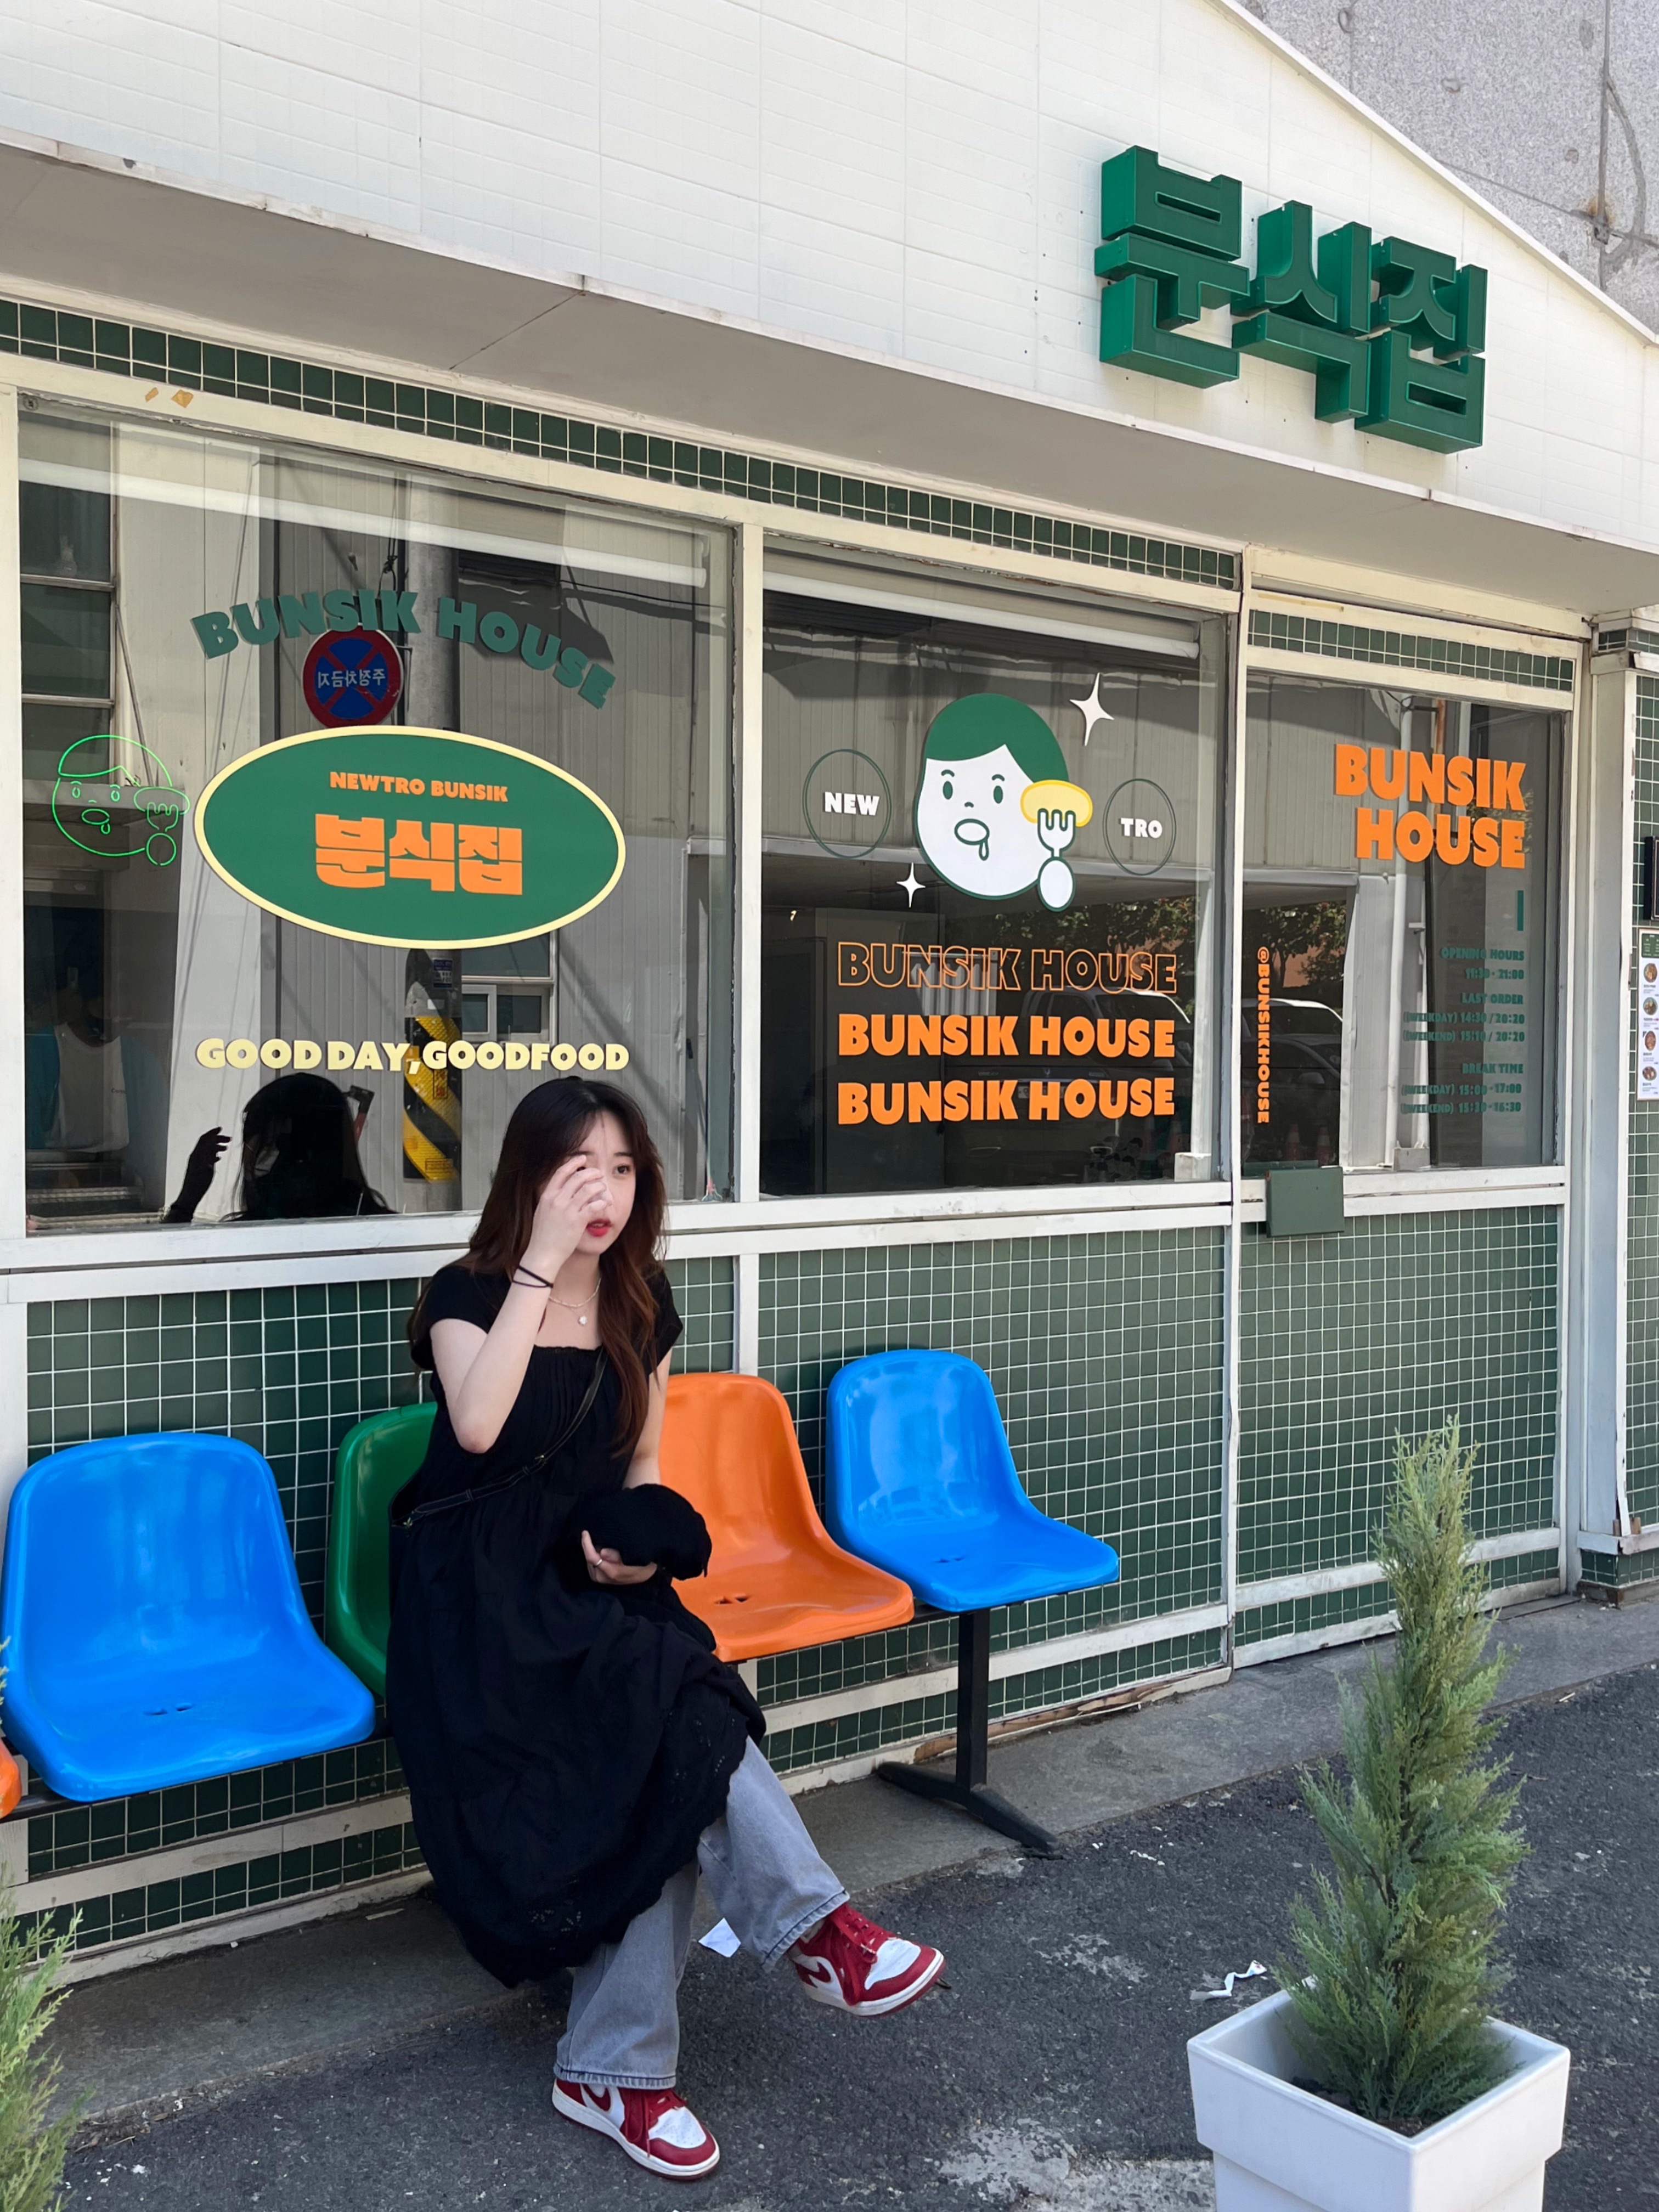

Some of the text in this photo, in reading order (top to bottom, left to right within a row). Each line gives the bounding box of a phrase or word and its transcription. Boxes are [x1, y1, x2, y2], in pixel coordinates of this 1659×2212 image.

[1095, 145, 1487, 454] 분식집
[191, 589, 616, 709] BUNSIK HOUSE
[330, 772, 508, 803] NEWTRO BUNSIK
[1335, 744, 1526, 811] BUNSIK
[825, 792, 879, 816] NEW
[1120, 817, 1163, 838] TRO
[1356, 807, 1526, 869] HOUSE
[315, 814, 523, 895] 분식집
[838, 942, 1176, 994] BUNSIK HOUSE
[1441, 947, 1524, 961] OPENING HOURS
[1465, 968, 1489, 979] 11:30
[1498, 969, 1524, 979] 21:00
[1462, 992, 1523, 1005] LAST ORDER
[838, 1013, 1175, 1058] BUNSIK HOUSE
[1257, 946, 1270, 1124] @BUNSIKHOUSE
[1496, 1031, 1525, 1042] 20:20
[198, 1039, 321, 1069] GOOD
[1463, 1063, 1523, 1074] BREAK TIME
[838, 1078, 1175, 1125] BUNSIK HOUSE
[1459, 1085, 1487, 1095] 15:00
[1494, 1083, 1522, 1093] 17:00
[1459, 1102, 1487, 1113] 15:30
[1494, 1102, 1521, 1112] 16:30
